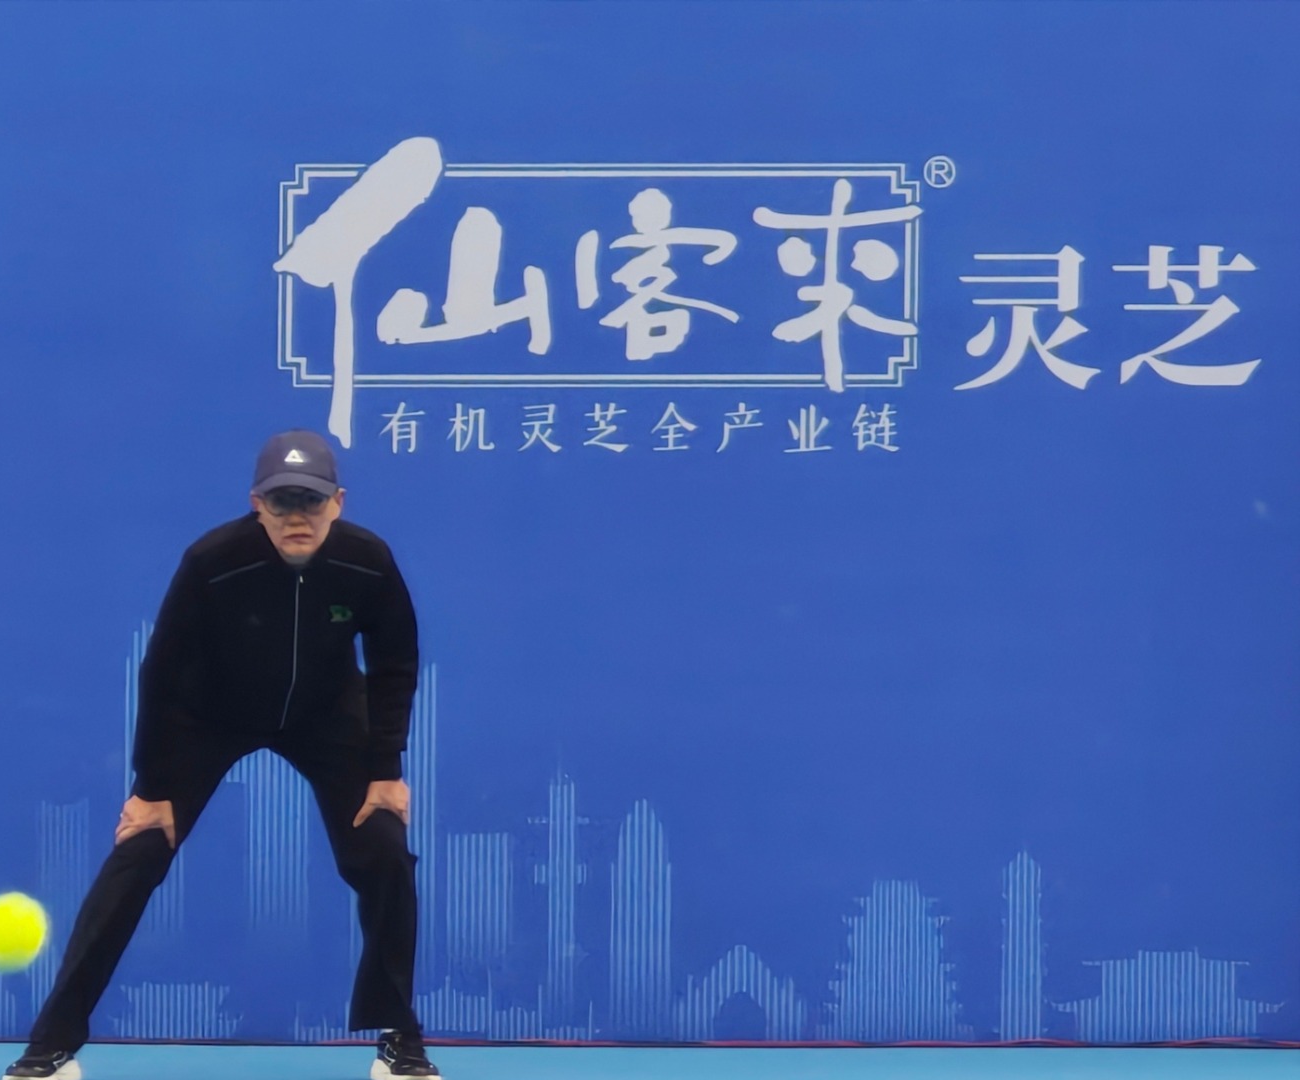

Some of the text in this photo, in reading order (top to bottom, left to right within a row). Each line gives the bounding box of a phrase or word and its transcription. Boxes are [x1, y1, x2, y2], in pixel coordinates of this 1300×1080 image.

[954, 245, 1262, 391] 灵芝
[381, 402, 900, 454] 有机灵芝全产业链
